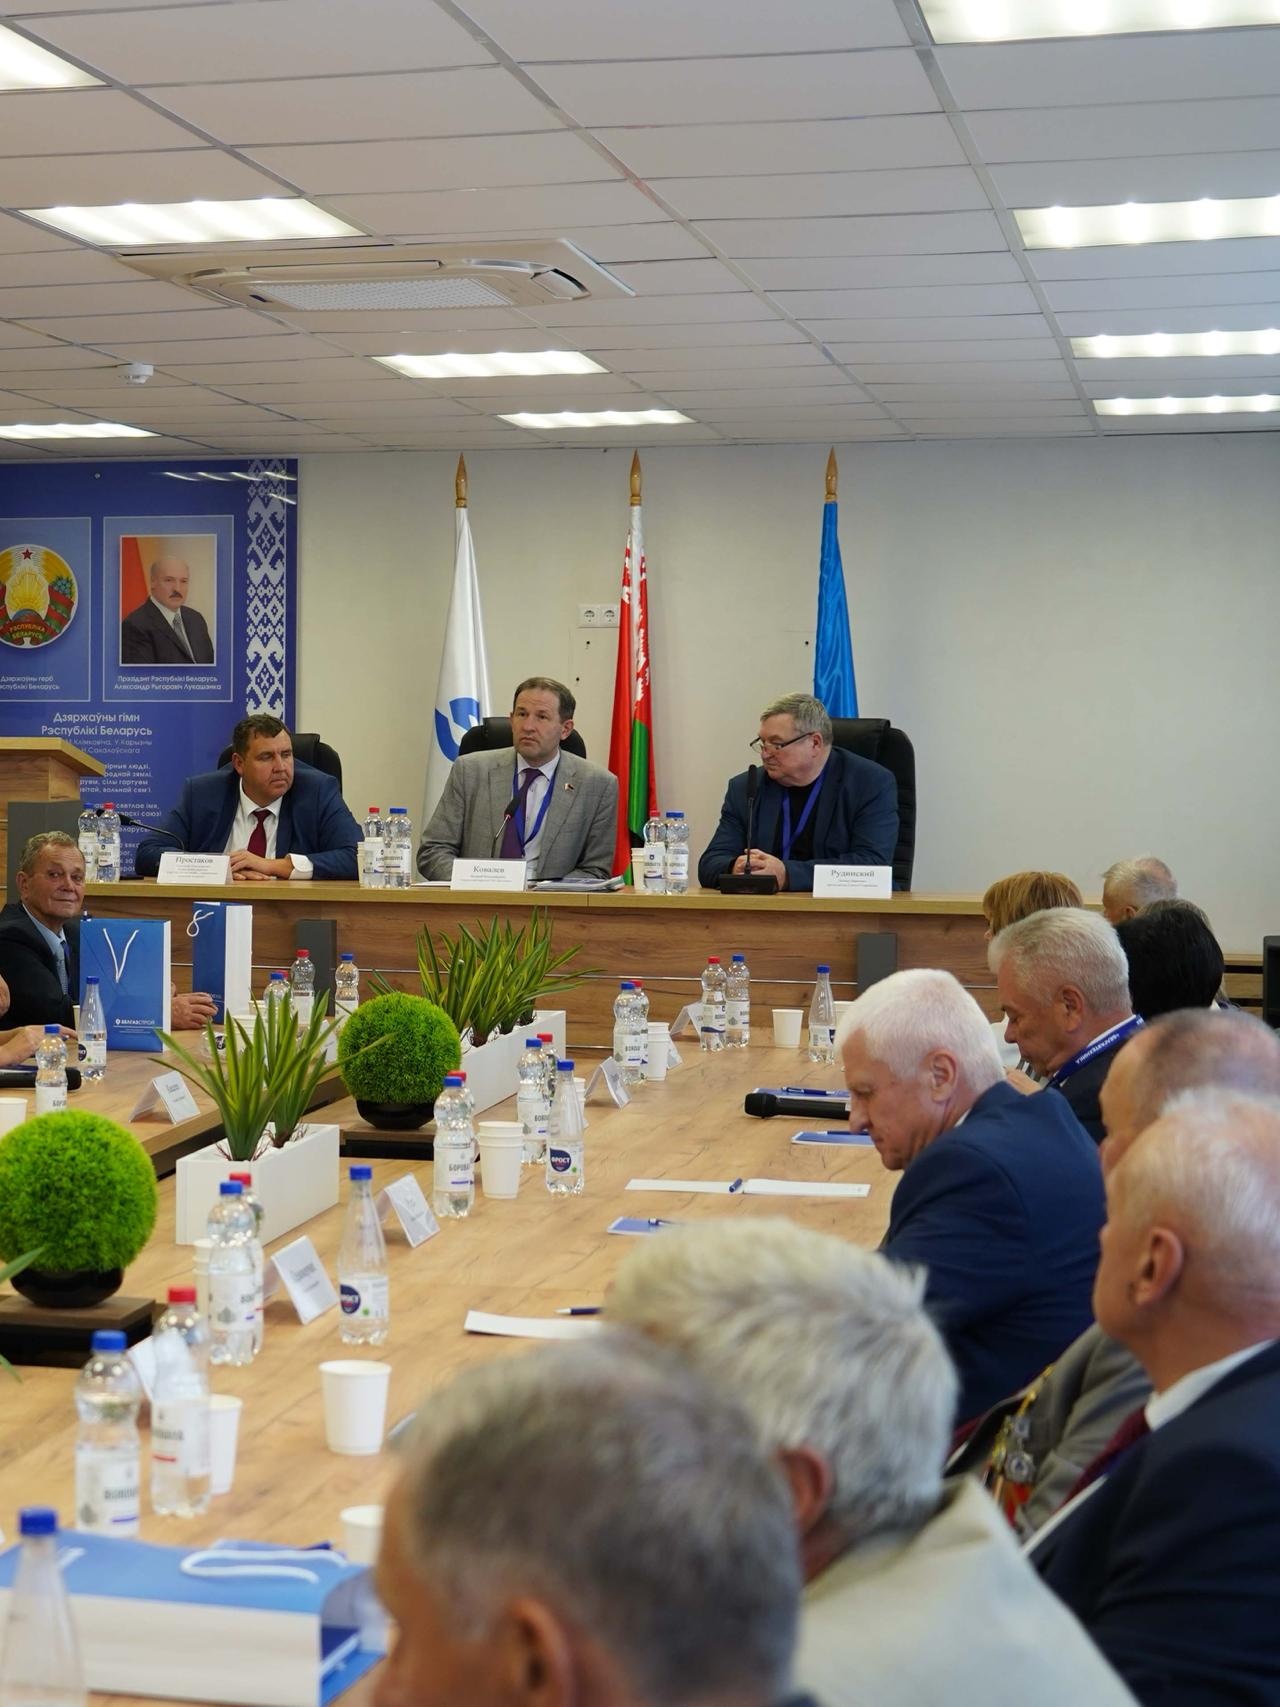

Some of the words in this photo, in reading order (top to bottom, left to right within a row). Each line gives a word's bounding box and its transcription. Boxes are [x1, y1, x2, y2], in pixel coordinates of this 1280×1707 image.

[53, 713, 116, 723] Дзяржаўны
[118, 713, 140, 721] гімн
[41, 725, 97, 736] Рэспублікі
[100, 725, 153, 736] Беларусь
[175, 856, 214, 864] Простаков
[831, 869, 875, 878] Рудинский
